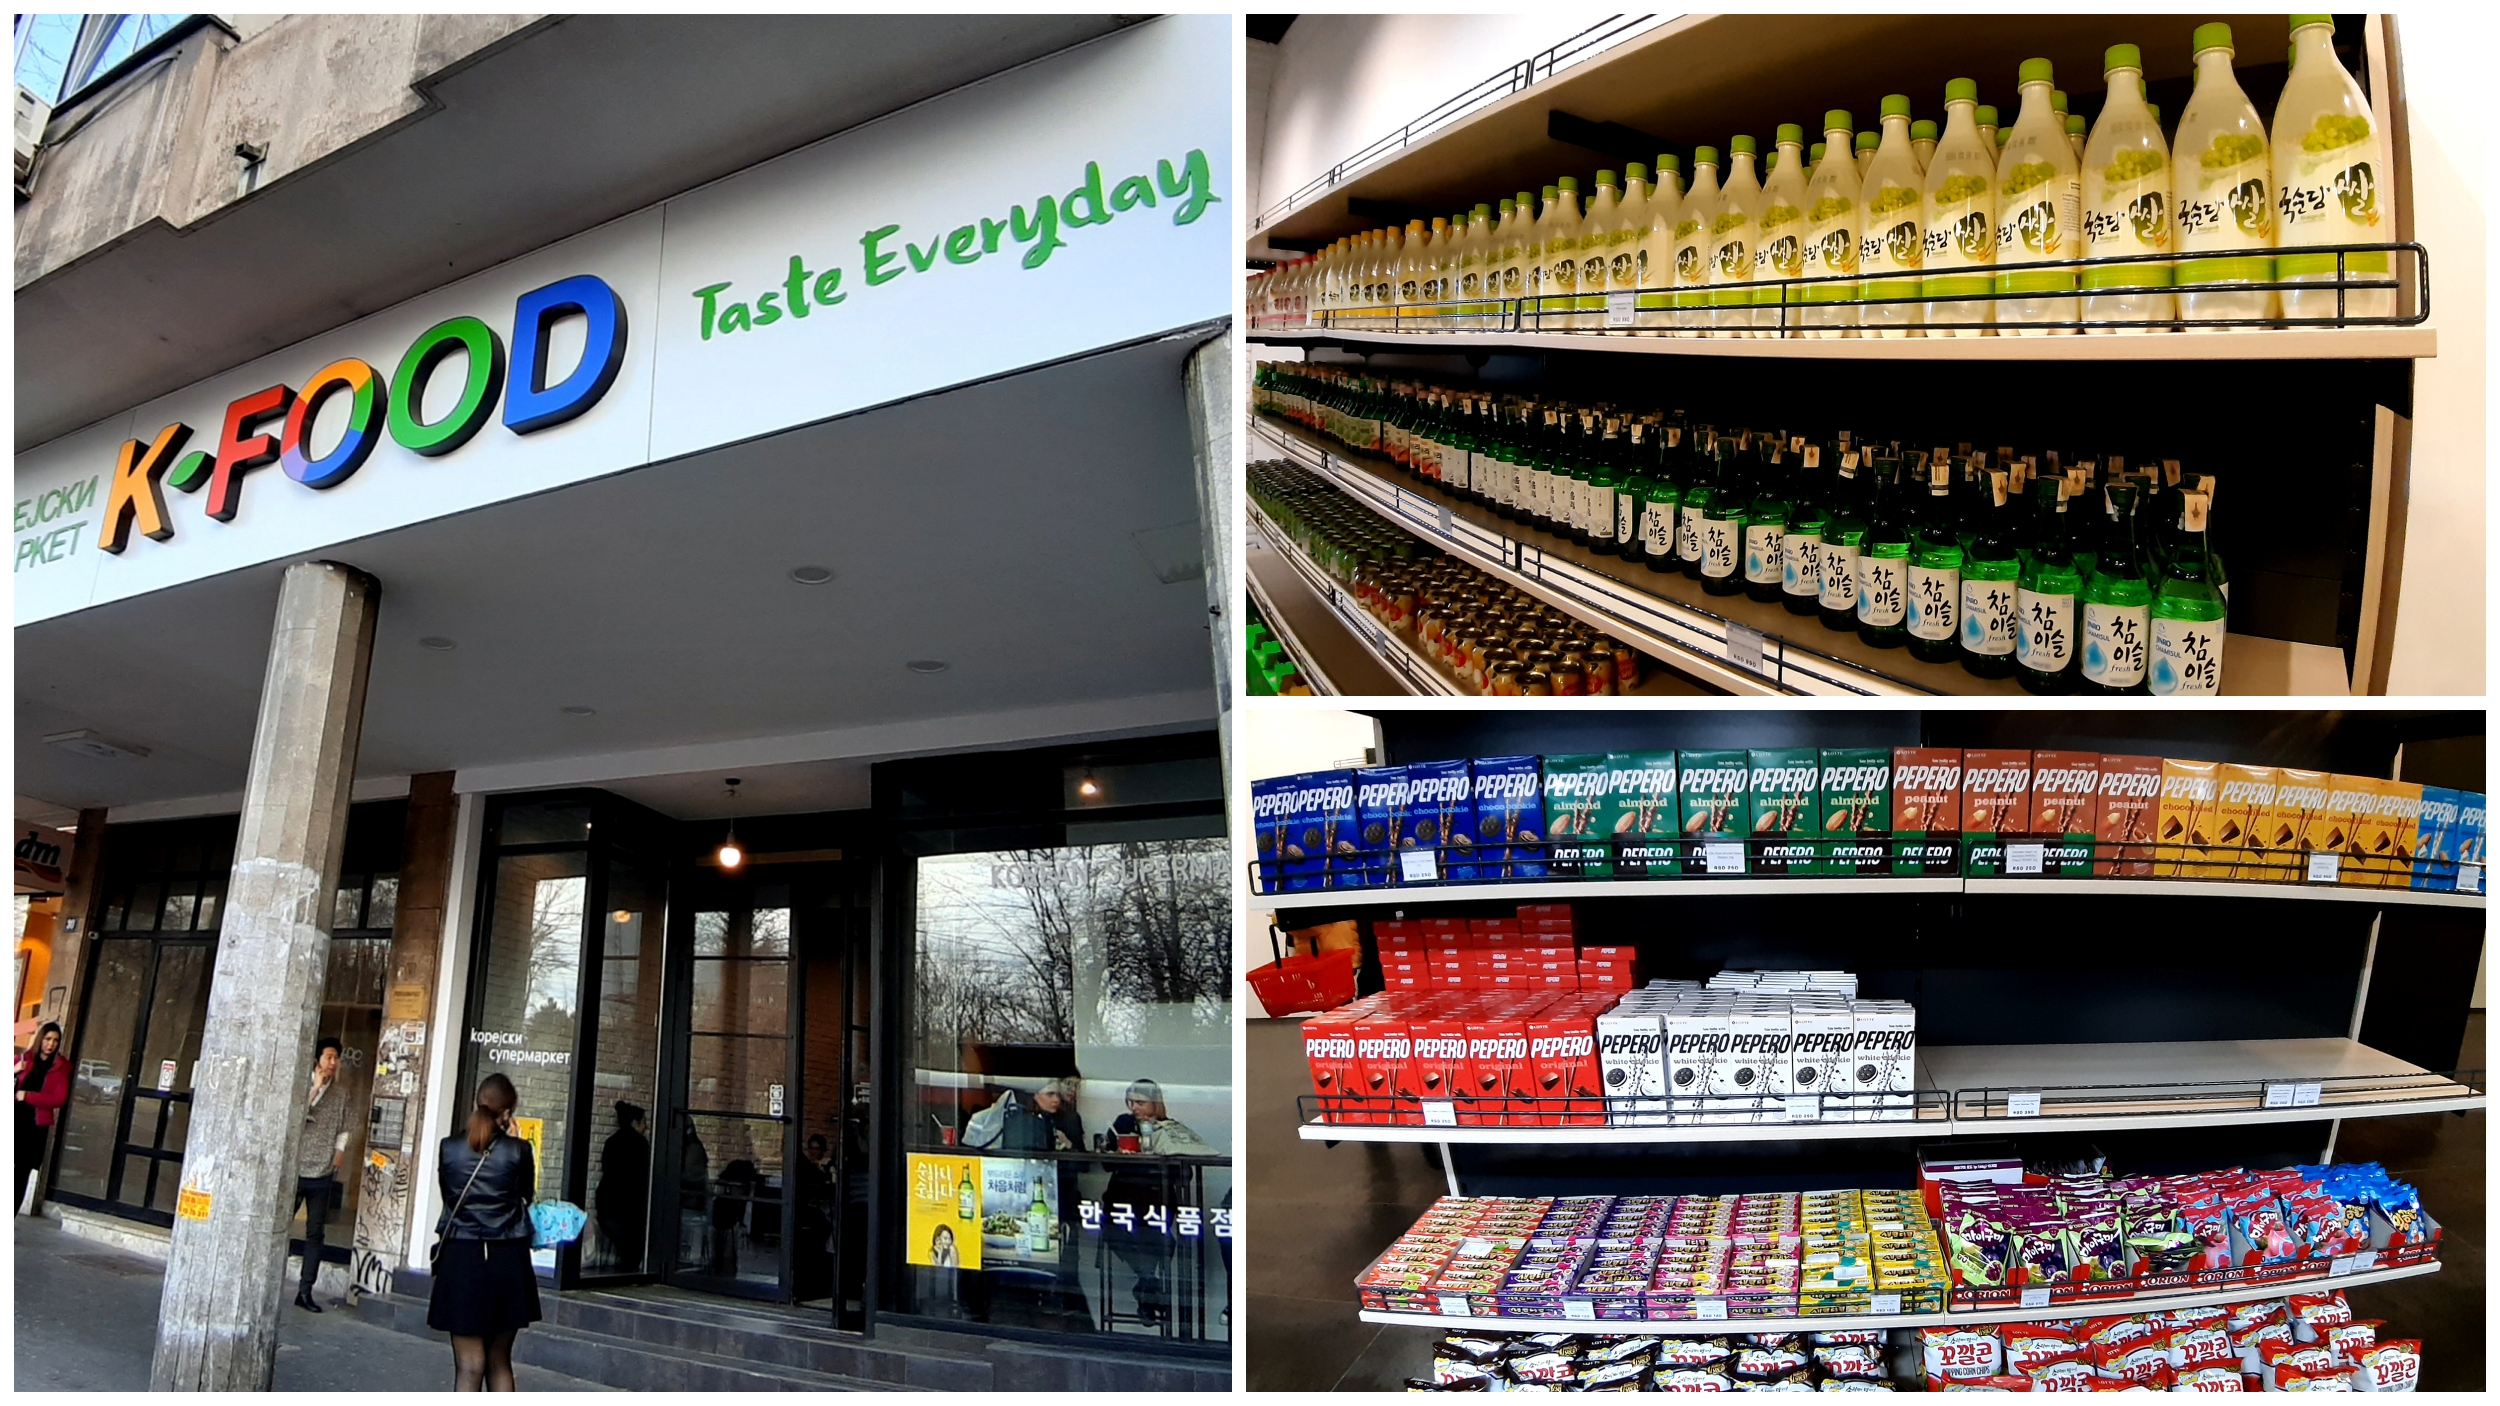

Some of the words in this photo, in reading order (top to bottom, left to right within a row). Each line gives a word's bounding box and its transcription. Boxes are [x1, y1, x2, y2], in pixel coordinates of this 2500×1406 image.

[2278, 185, 2327, 224] 국순당
[2083, 210, 2123, 243] 국순당
[2178, 199, 2223, 234] 국순당
[692, 255, 848, 341] Taste
[859, 148, 1223, 286] Everyday
[1648, 508, 1661, 527] 참
[1682, 512, 1693, 532] 참
[1649, 526, 1667, 546] 이슬
[1683, 532, 1698, 552] 이슬
[1708, 526, 1725, 547] 참
[1764, 532, 1783, 551] 참
[1709, 545, 1732, 567] 이슬
[1800, 542, 1818, 563] 참
[1827, 552, 1846, 576] 참
[1829, 574, 1854, 599] 이슬
[1872, 566, 1893, 591] 참
[1875, 587, 1901, 614] 이슬
[1922, 577, 1945, 603] 참
[1987, 590, 2010, 615] 참
[1922, 619, 1940, 627] fresh
[1924, 600, 1952, 627] 이슬
[2031, 602, 2057, 631] 참
[1990, 612, 2017, 640] 이슬
[2111, 616, 2138, 644] 참
[1988, 634, 2006, 642] fresh
[2034, 629, 2065, 658] 이슬
[2182, 631, 2211, 661] 참
[2031, 649, 2051, 658] fresh
[2114, 641, 2144, 671] 이슬
[2110, 664, 2131, 673] fresh
[2185, 657, 2216, 689] 이슬
[2180, 682, 2203, 691] fresh
[1474, 773, 1538, 800] PEPERO
[1544, 769, 1608, 797] PEPERO
[1608, 768, 1676, 795] PEPERO
[1679, 768, 1748, 794] PEPERO
[1750, 767, 1818, 793] PEPERO
[1820, 766, 1889, 792] PEPERO
[1893, 765, 1961, 791] PEPERO
[1963, 768, 2030, 793] PEPERO
[2033, 769, 2098, 794] PEPERO
[2099, 772, 2161, 798] PEPERO
[2161, 776, 2217, 801] PEPERO
[1299, 785, 1353, 812] PEPERO
[1409, 777, 1470, 805] PEPERO
[1759, 796, 1809, 806] almond
[1830, 796, 1879, 806] almond
[1904, 794, 1948, 805] peanut
[1974, 795, 2017, 806] peanut
[2219, 780, 2275, 806] PEPERO
[2275, 785, 2328, 810] PEPERO
[2327, 789, 2376, 814] PEPERO
[1252, 791, 1299, 817] PEPERO
[1414, 807, 1439, 815] choco
[1440, 805, 1469, 815] cookie
[1478, 803, 1504, 812] choco
[1505, 801, 1537, 811] cookie
[1553, 800, 1601, 811] almond
[1618, 798, 1668, 808] almond
[1690, 797, 1739, 807] almond
[2043, 797, 2085, 807] peanut
[2109, 801, 2149, 810] peanut
[2163, 803, 2189, 813] choco
[2221, 807, 2249, 816] choco
[2376, 796, 2421, 819] PEPERO
[2420, 799, 2458, 823] PEPERO
[2277, 811, 2303, 820] choco
[2329, 815, 2354, 825] choco
[2376, 820, 2398, 829] choco
[14, 830, 61, 867] dm
[991, 861, 1091, 889] KOREAN
[1306, 1038, 1355, 1058] PEPERO
[1358, 1038, 1411, 1058] PEPERO
[1414, 1038, 1467, 1059] PEPERO
[1469, 1038, 1527, 1059] PEPERO
[1530, 1035, 1593, 1059] PEPERO
[1600, 1033, 1661, 1053] PEPERO
[1669, 1033, 1731, 1053] PEPERO
[1730, 1033, 1791, 1053] PEPERO
[1793, 1032, 1854, 1053] PEPERO
[1854, 1031, 1915, 1051] PEPERO
[489, 1048, 571, 1066] супермаркет
[1315, 1061, 1353, 1071] original
[1367, 1061, 1408, 1071] original
[1422, 1061, 1465, 1071] original
[1479, 1061, 1523, 1071] original
[1540, 1059, 1589, 1071] original
[1605, 1058, 1629, 1066] white
[1630, 1057, 1660, 1066] cookie
[1673, 1058, 1697, 1066] white
[1734, 1057, 1758, 1066] white
[1796, 1056, 1820, 1065] white
[1857, 1054, 1880, 1062] white
[1881, 1054, 1911, 1062] cookie
[987, 1179, 1027, 1194] 처음처럼
[2147, 1275, 2190, 1287] ORION
[1938, 1341, 1993, 1367] 꼬깔콘
[1963, 1367, 1976, 1375] CORN
[1977, 1365, 1990, 1374] CHIPS
[2373, 1358, 2416, 1385] 꼬깔콘
